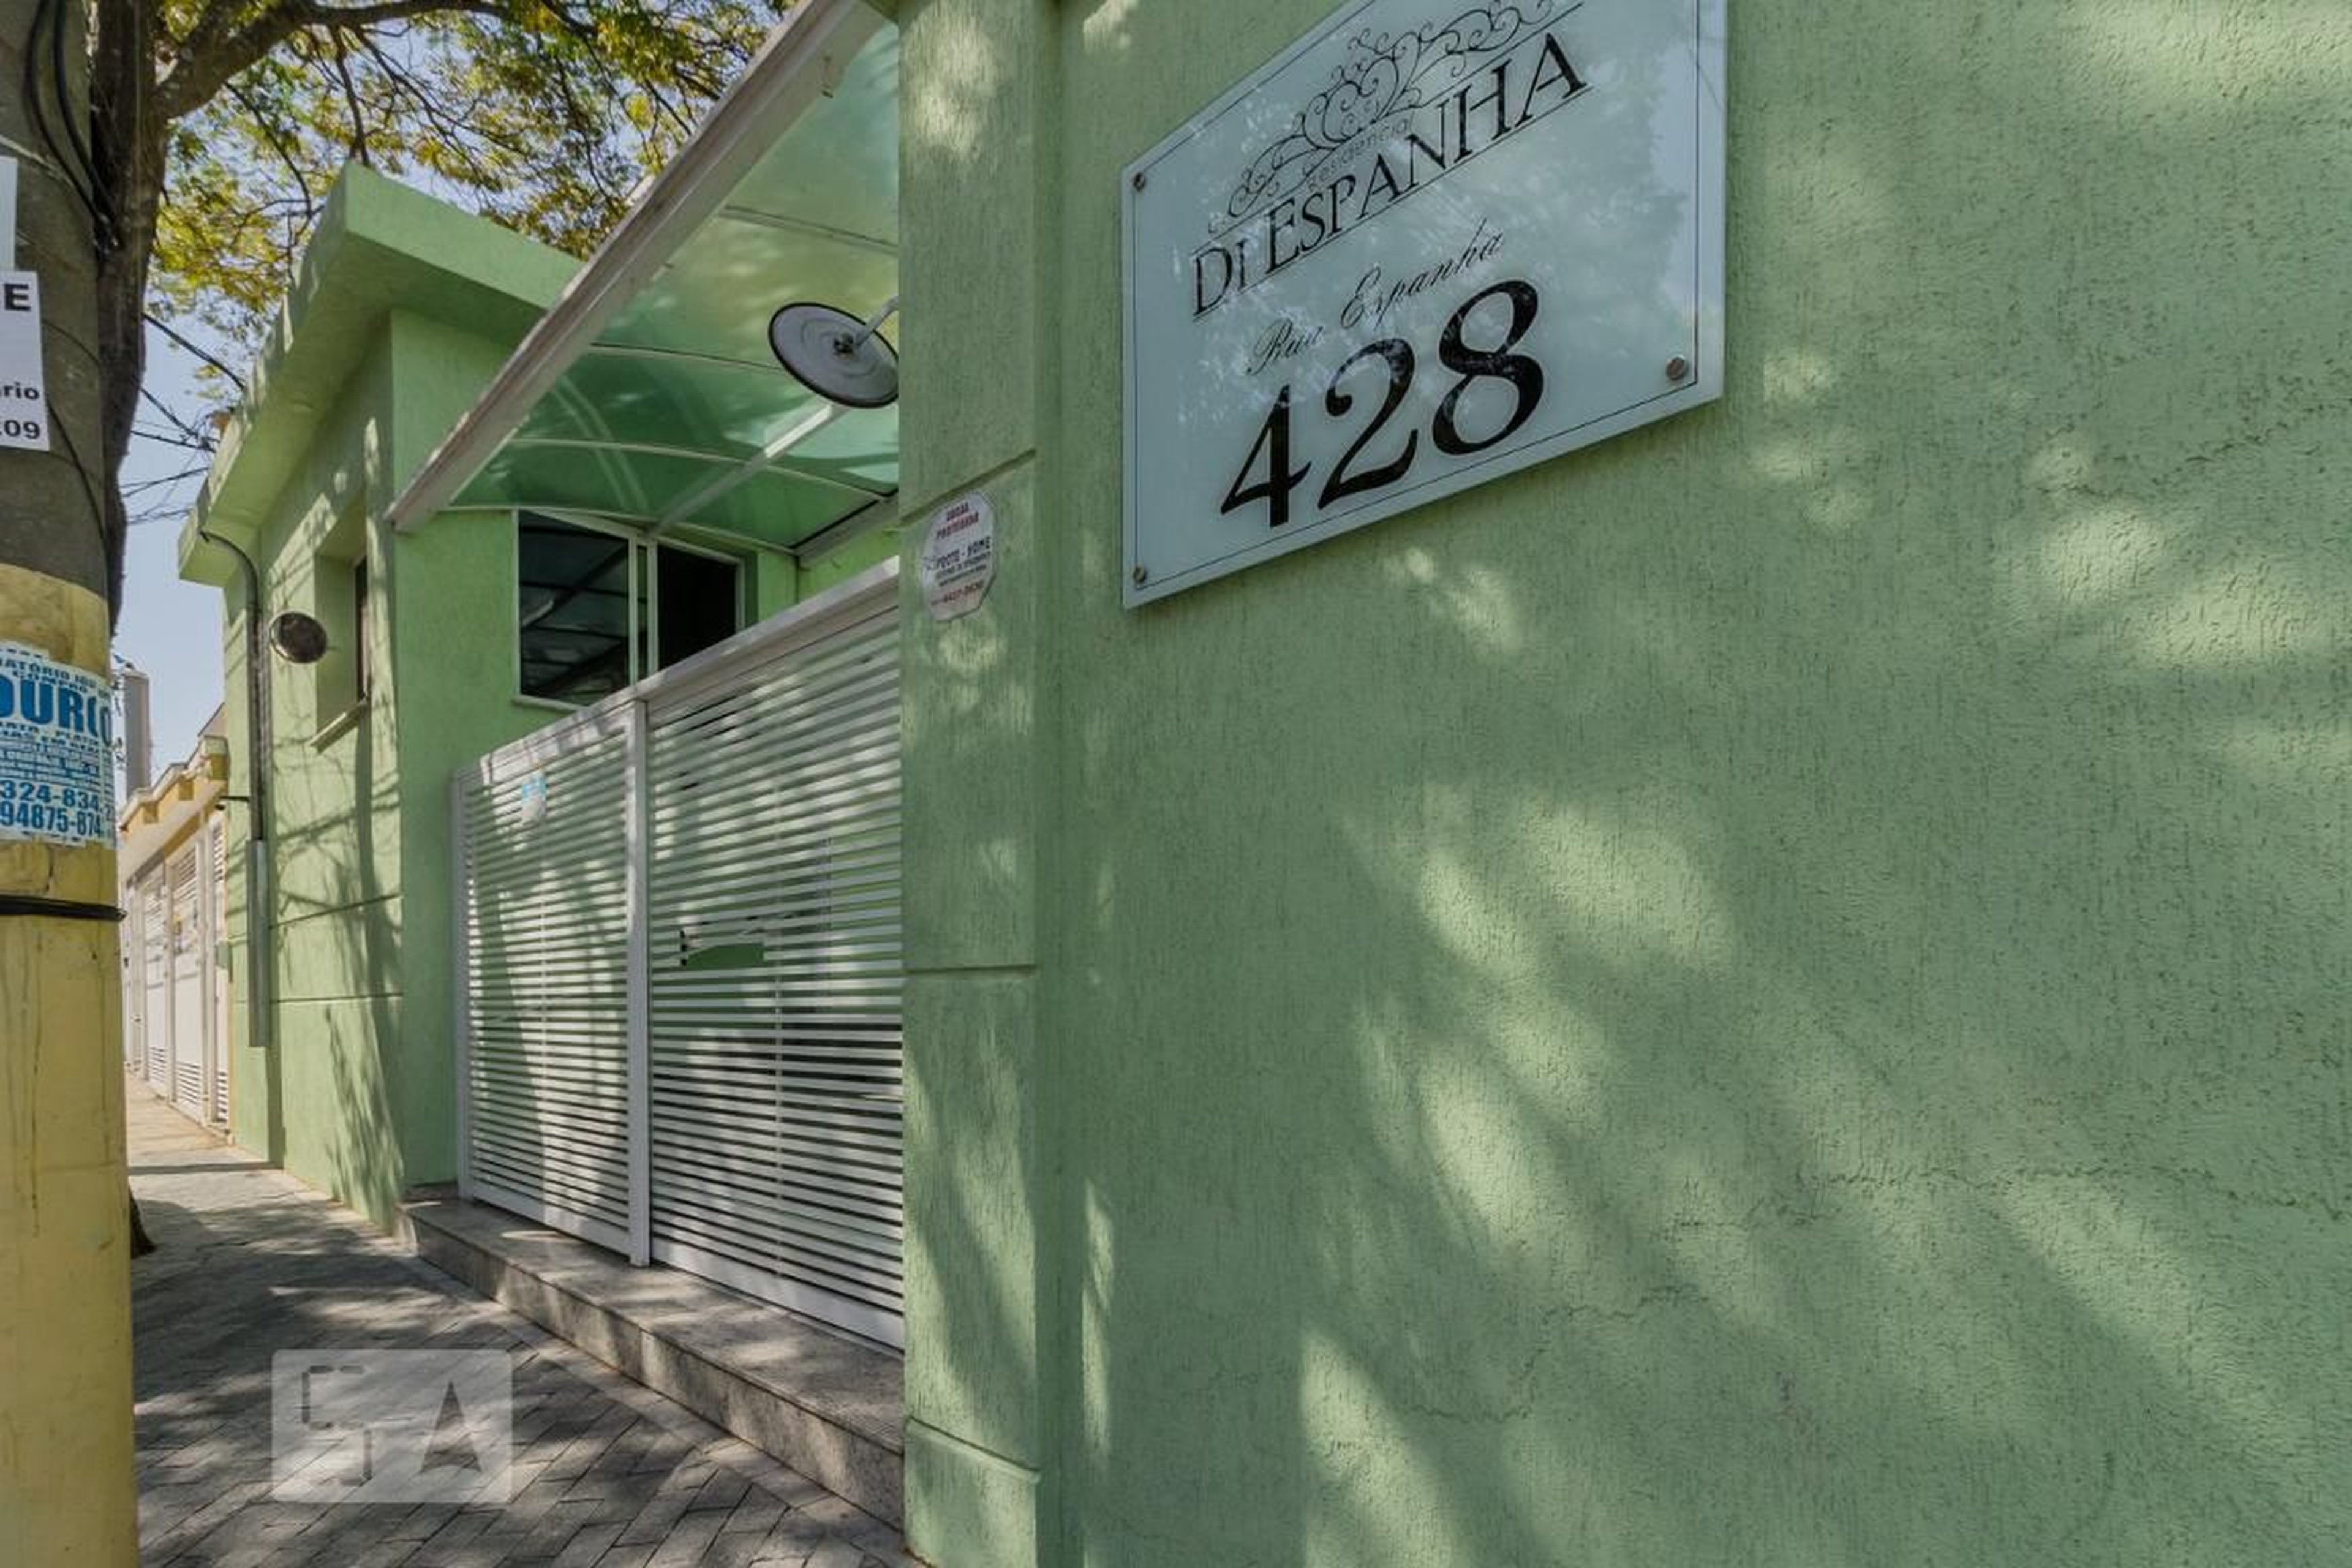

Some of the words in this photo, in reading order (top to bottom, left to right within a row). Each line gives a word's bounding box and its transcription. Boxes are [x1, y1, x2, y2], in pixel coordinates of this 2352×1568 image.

[1193, 240, 1248, 317] DI
[1264, 32, 1589, 276] ESPANHA
[0, 383, 40, 401] rio
[1219, 279, 1544, 528] 428
[1246, 317, 1326, 377] Rua
